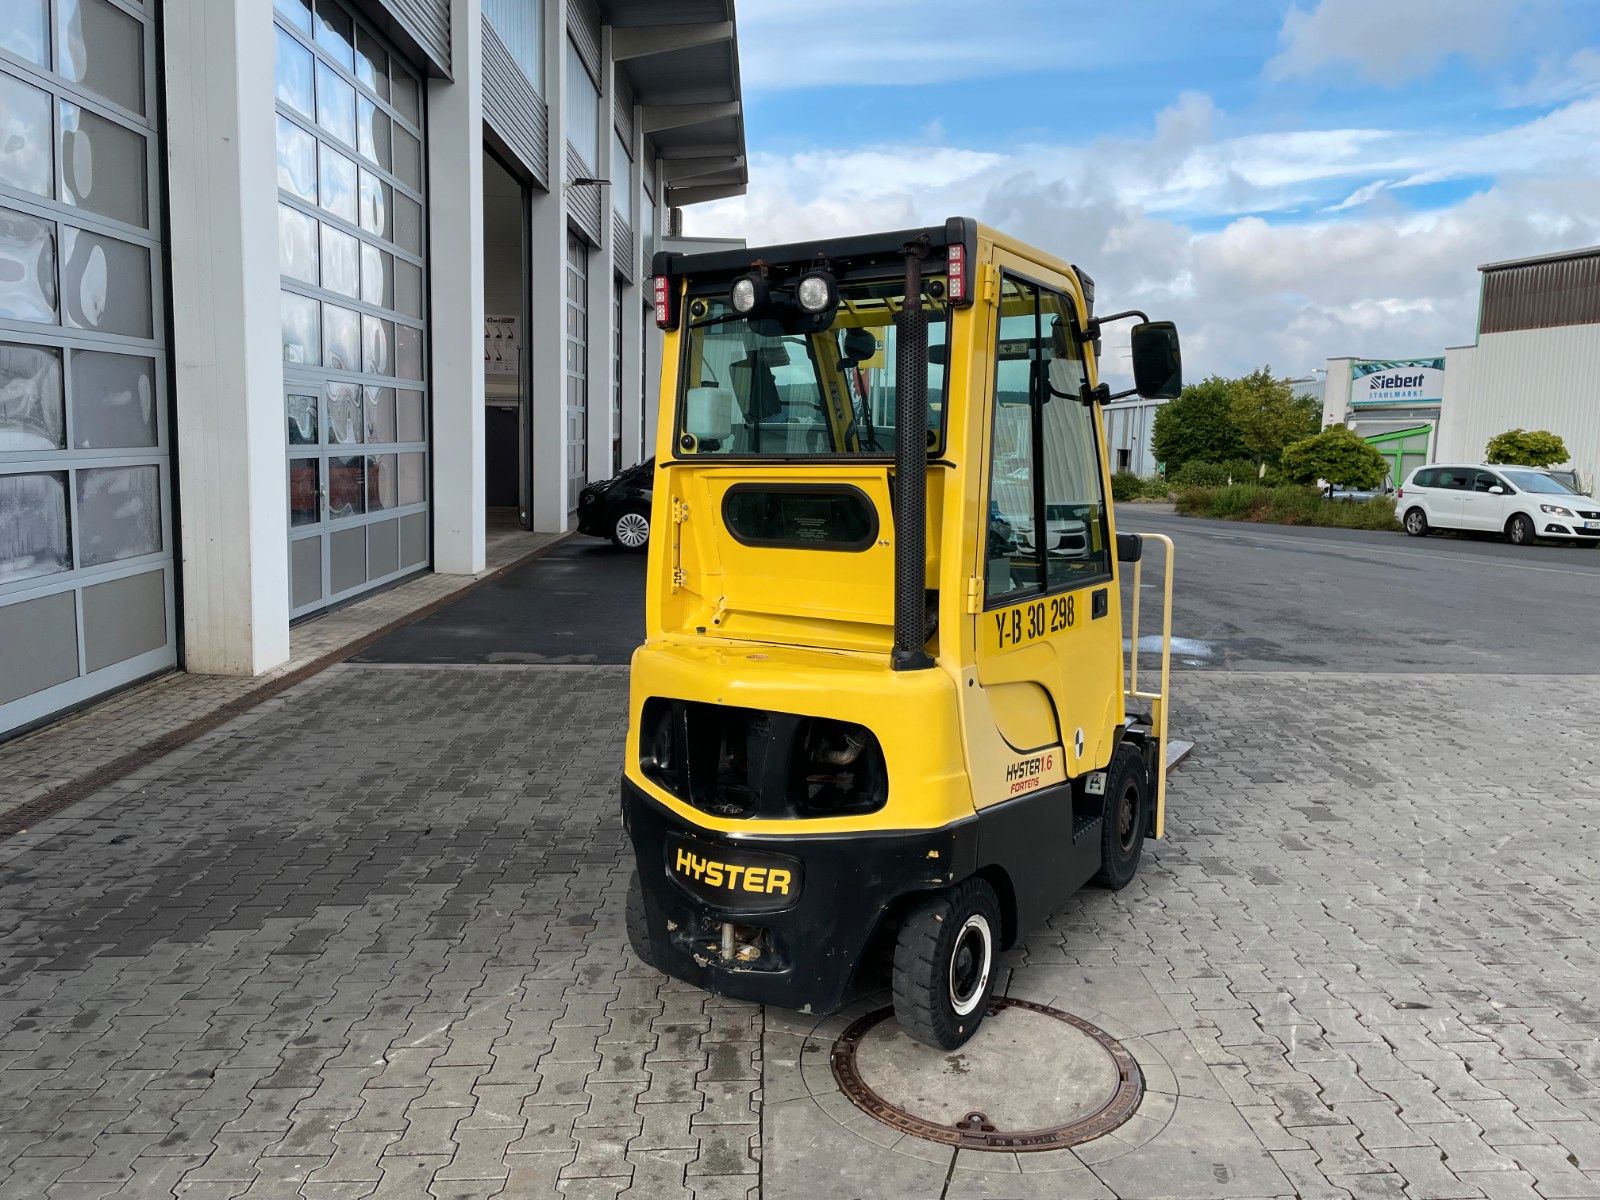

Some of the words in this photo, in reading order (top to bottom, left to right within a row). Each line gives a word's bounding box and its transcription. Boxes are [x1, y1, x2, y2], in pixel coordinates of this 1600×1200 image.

[1369, 390, 1423, 399] STAHLMARKT
[995, 611, 1022, 649] Y-B
[1027, 602, 1045, 639] 30
[1050, 595, 1075, 633] 298
[1006, 757, 1041, 782] HYSTER
[1010, 776, 1040, 794] FORTENS
[675, 848, 792, 895] HYSTER
